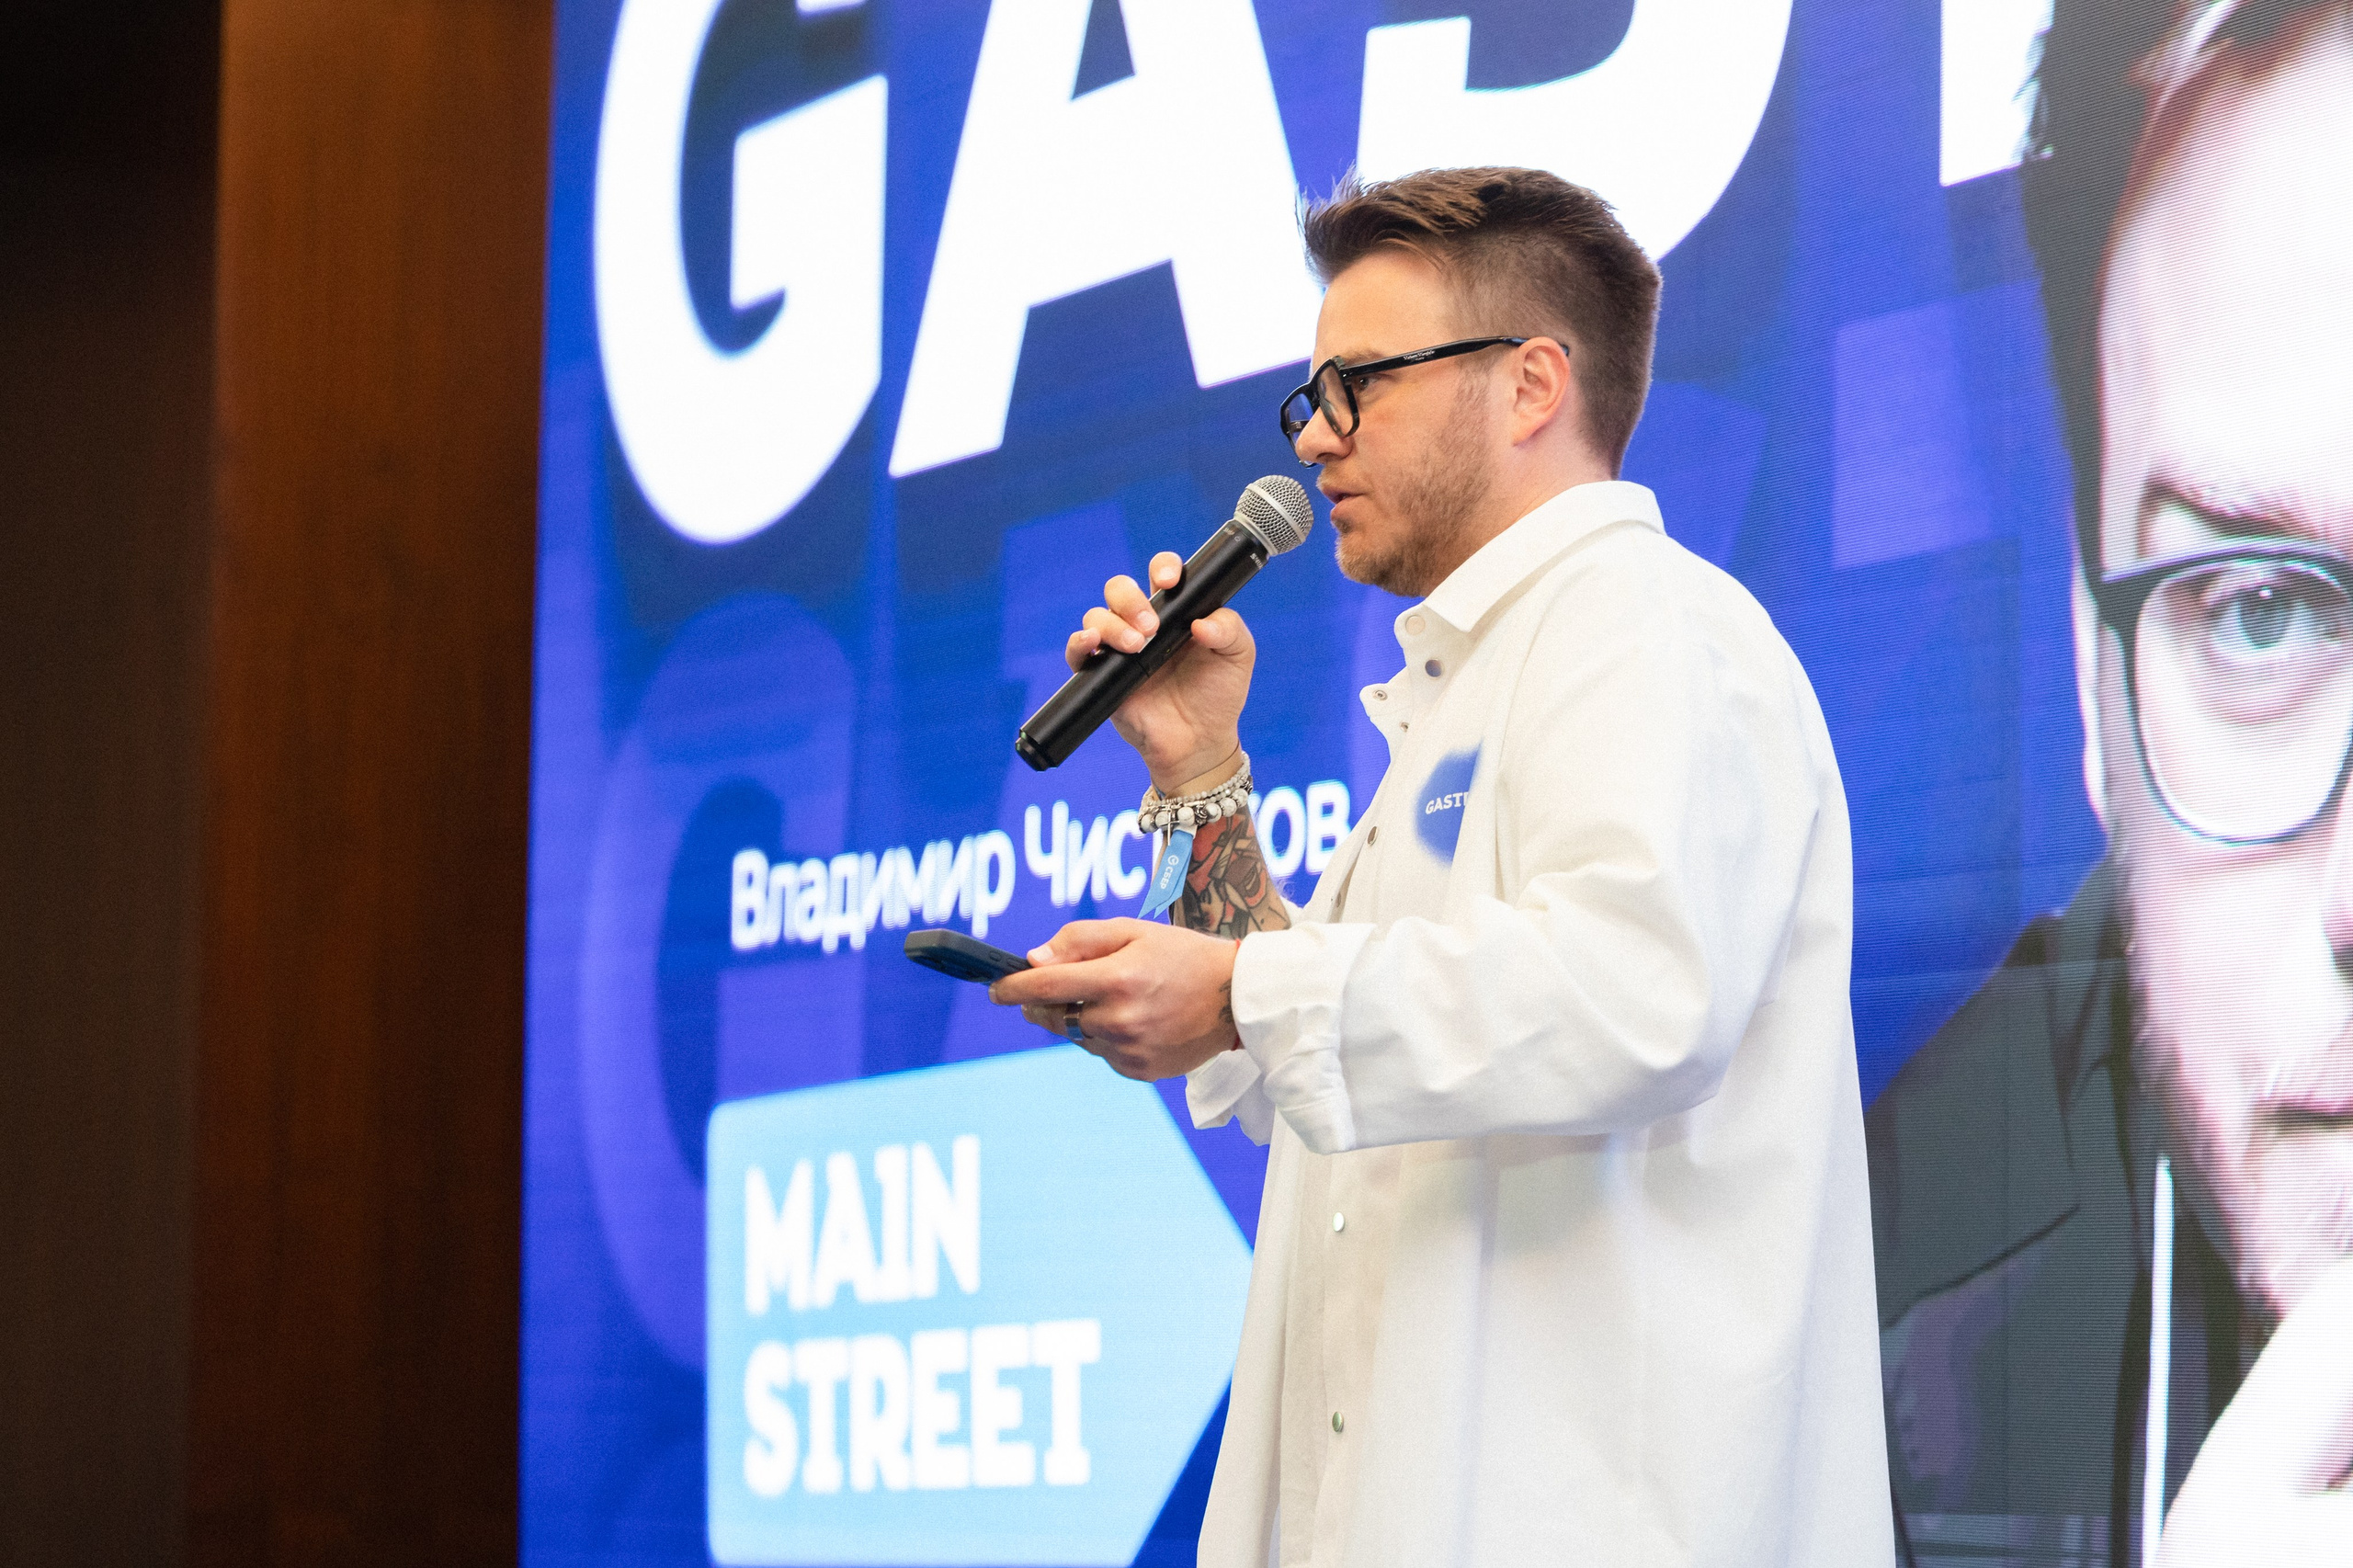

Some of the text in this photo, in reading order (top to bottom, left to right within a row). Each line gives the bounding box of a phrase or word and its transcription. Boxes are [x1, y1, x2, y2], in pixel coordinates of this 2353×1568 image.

[731, 778, 1352, 953] Владимир Чисов
[745, 1134, 981, 1316] MAIN
[744, 1318, 1101, 1498] STREET
